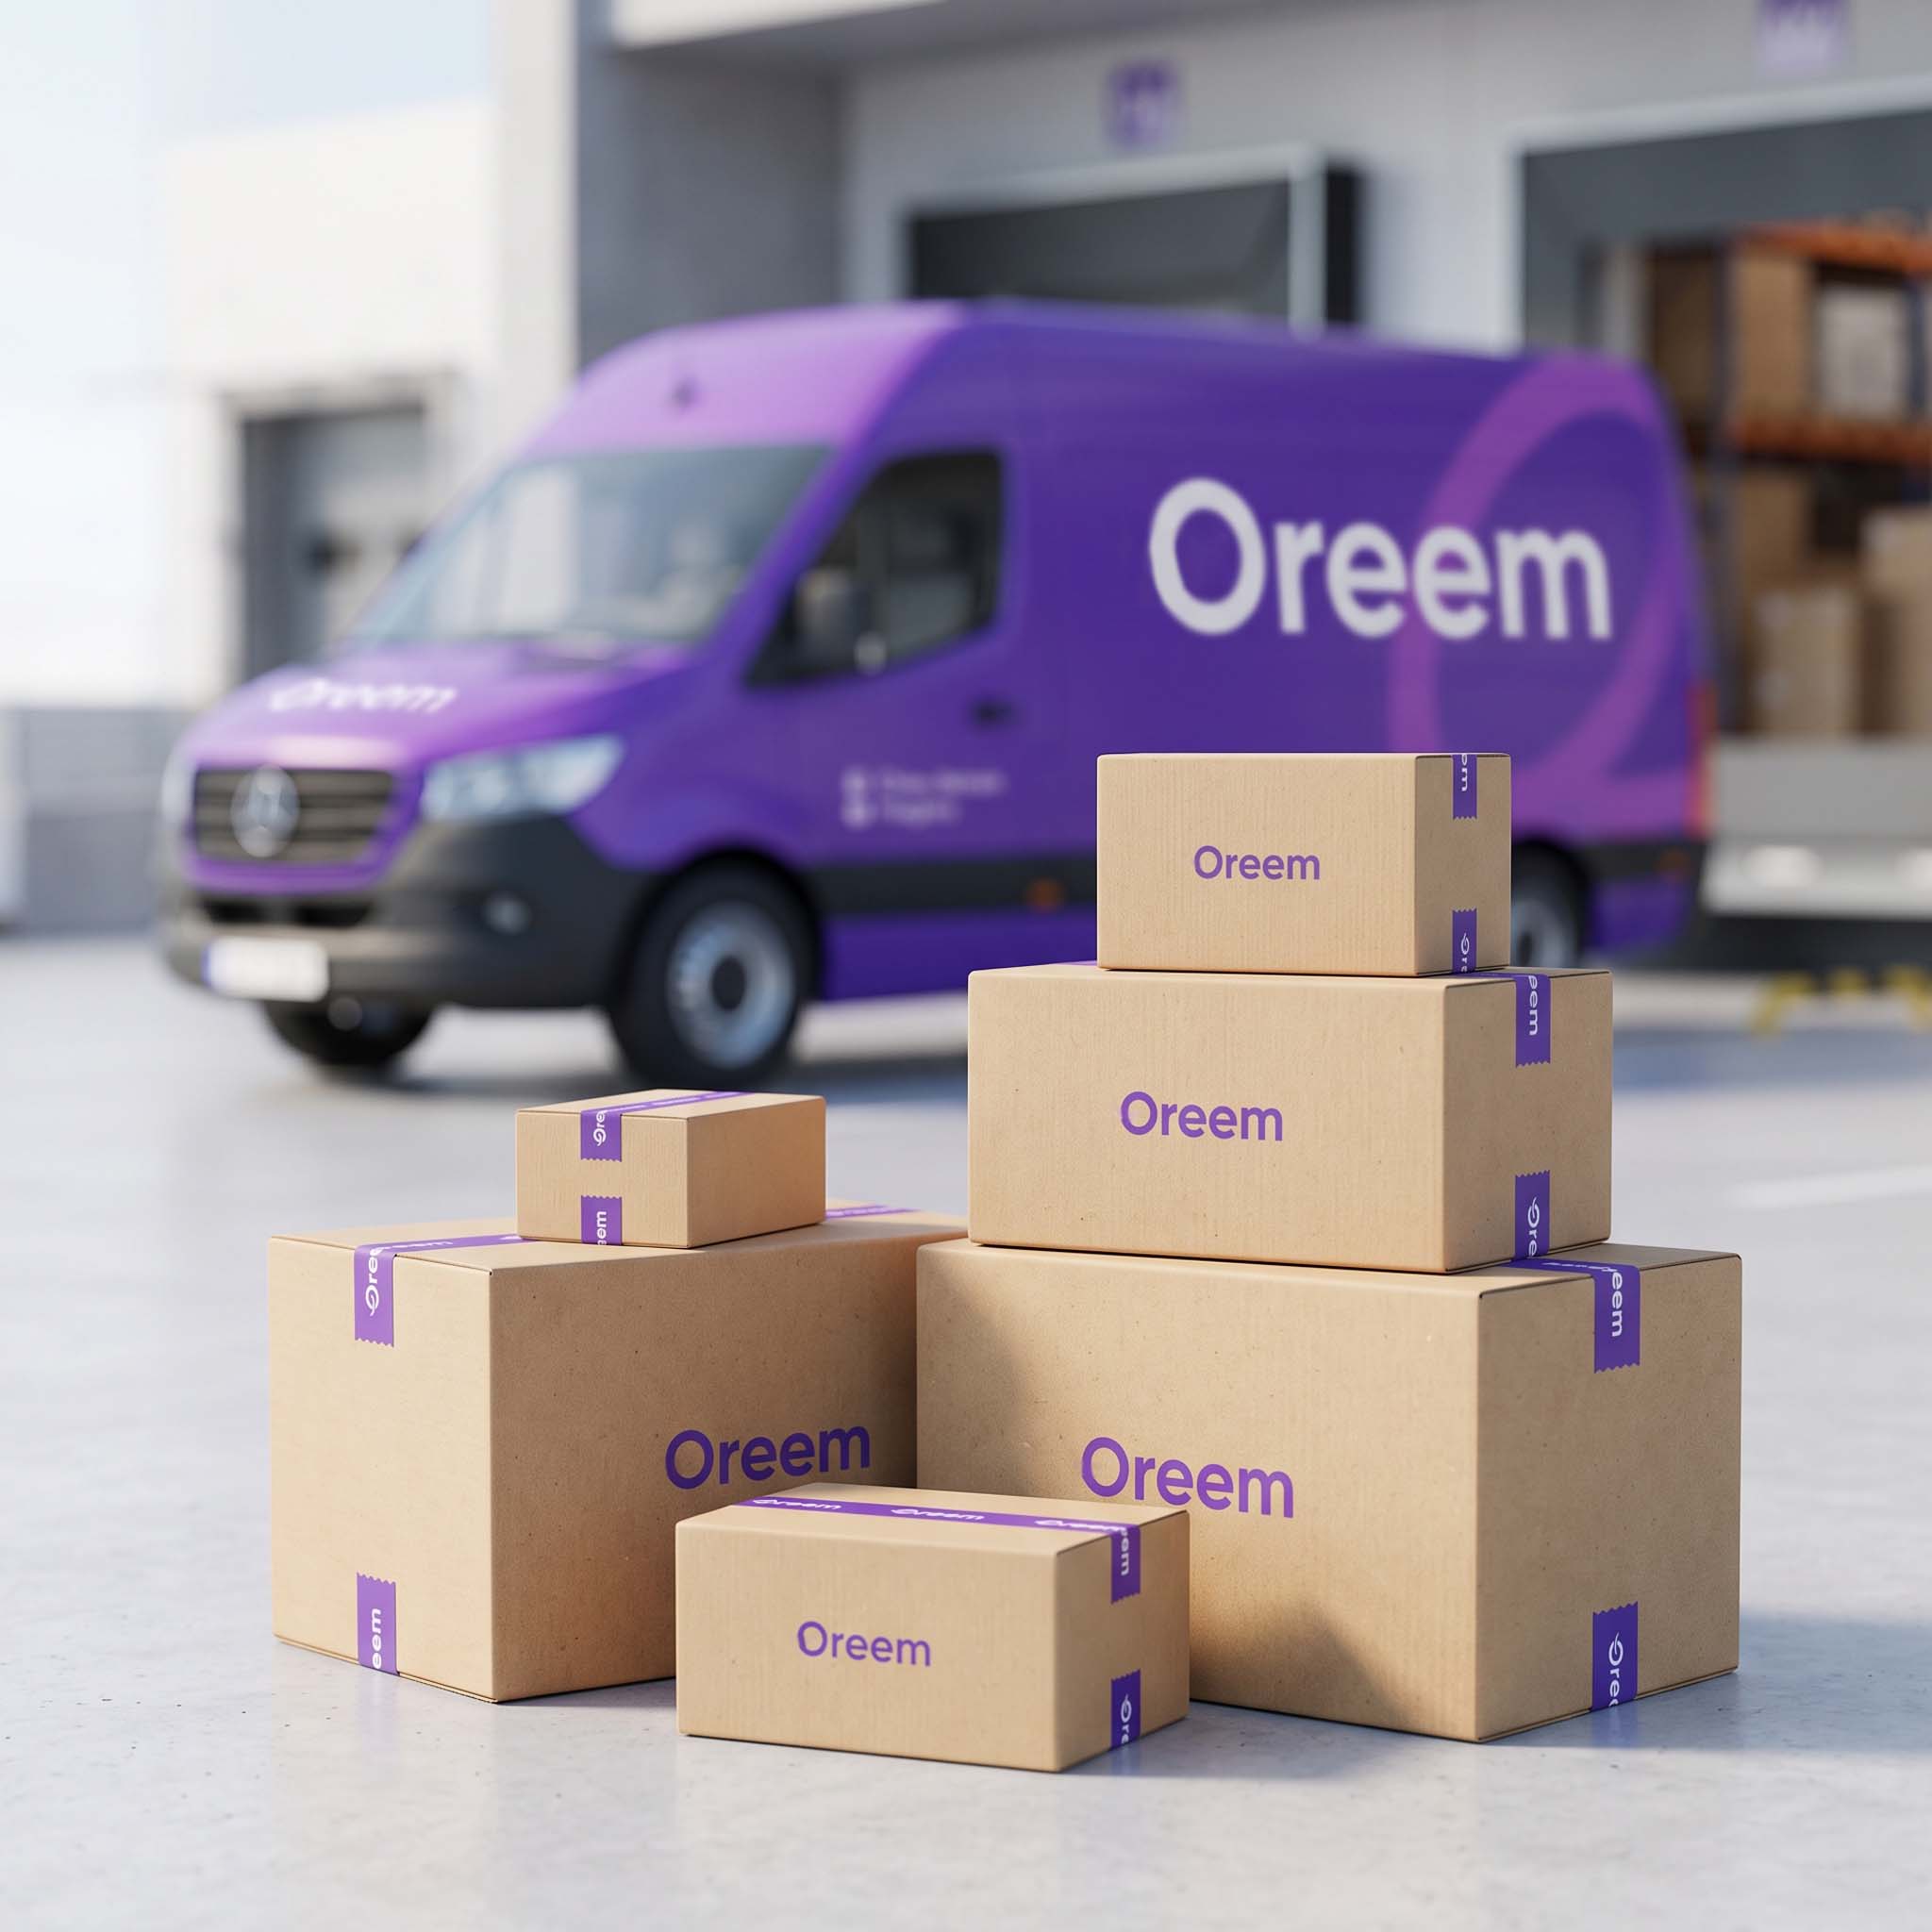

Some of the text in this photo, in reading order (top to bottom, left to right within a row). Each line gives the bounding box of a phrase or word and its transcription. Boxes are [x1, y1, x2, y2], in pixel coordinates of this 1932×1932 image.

[1148, 476, 1612, 641] Oreem
[1192, 844, 1322, 881] Oreem
[1119, 1091, 1284, 1141] Oreem
[665, 1426, 872, 1490] Oreem
[1081, 1436, 1295, 1519] Oreem
[796, 1620, 933, 1667] Oreem
